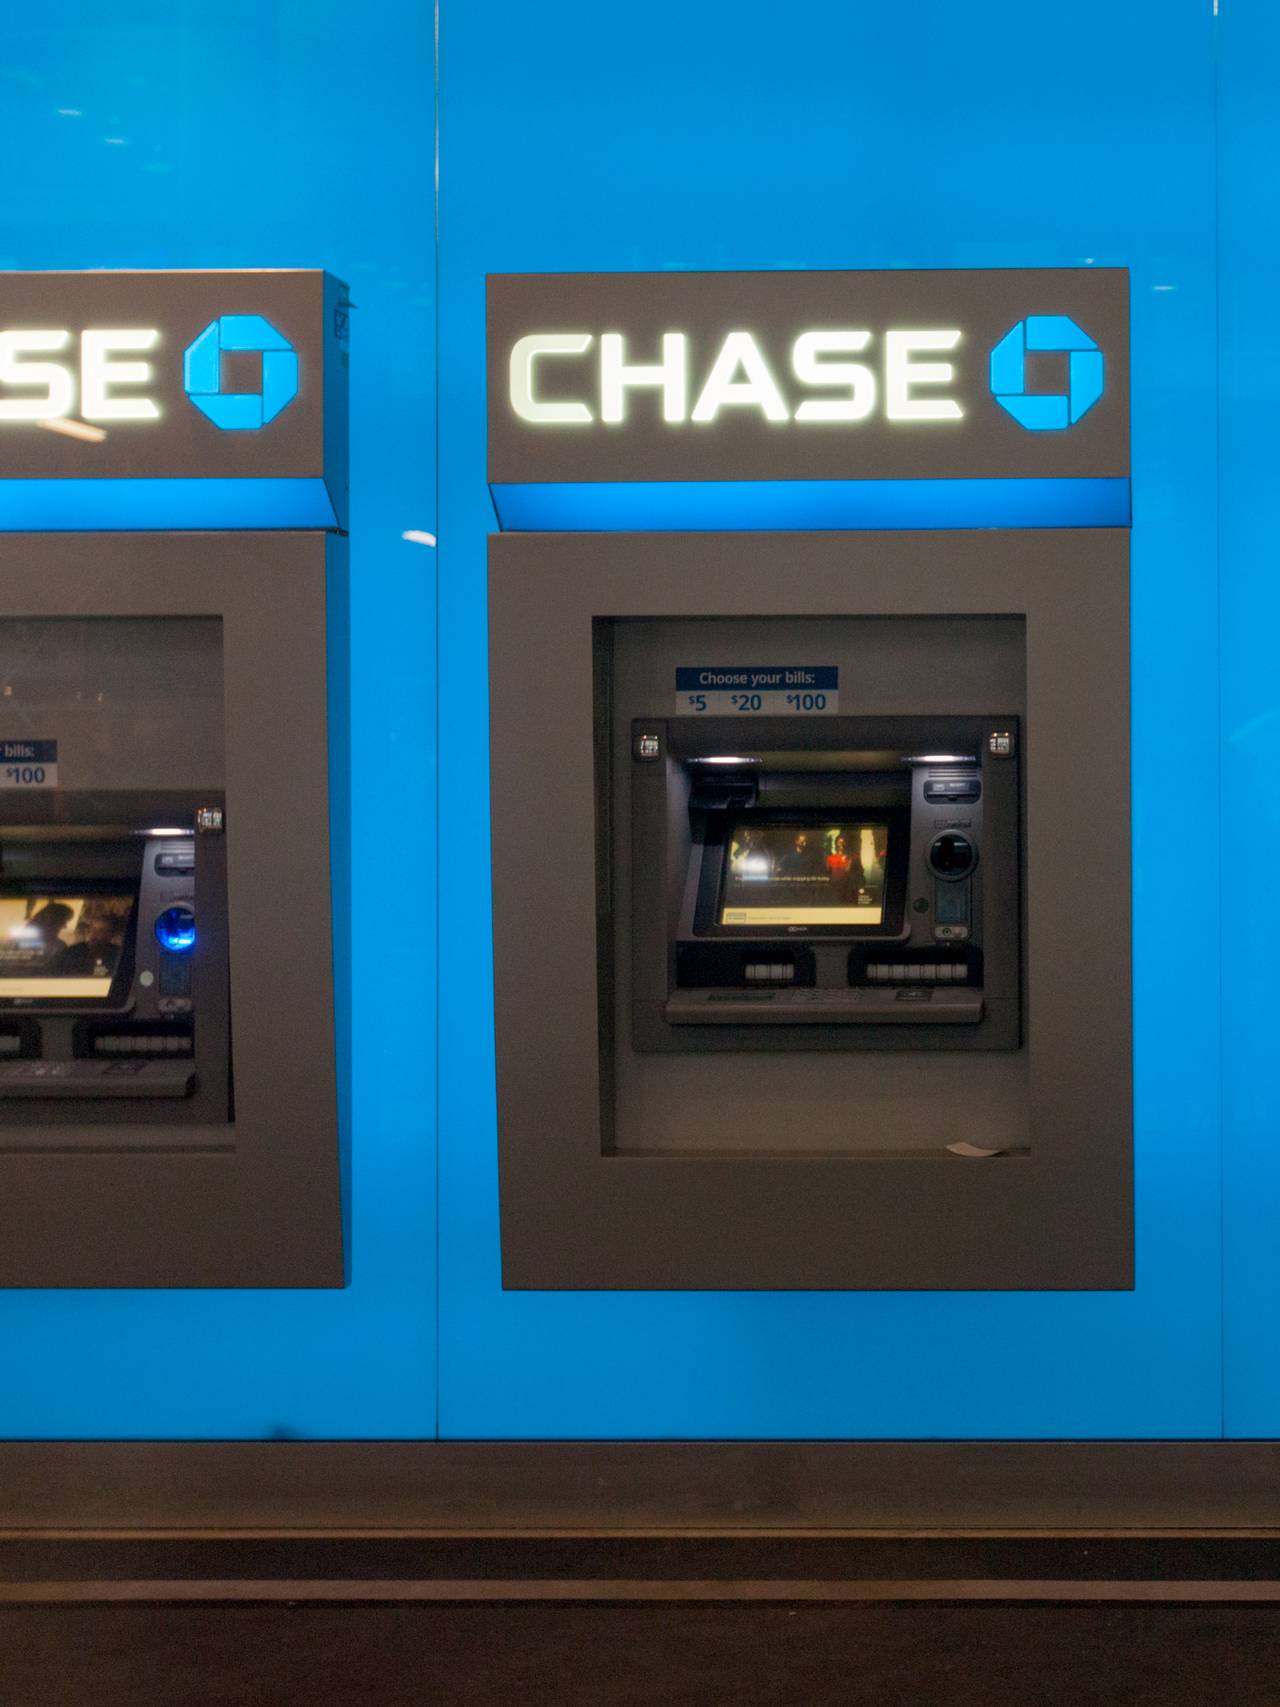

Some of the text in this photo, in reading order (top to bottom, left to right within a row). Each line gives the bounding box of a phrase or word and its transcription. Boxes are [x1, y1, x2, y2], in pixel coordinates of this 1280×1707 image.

[509, 330, 964, 422] CHASE
[700, 671, 816, 687] Choose your bills:
[688, 694, 827, 711] $5 $20 $100
[7, 767, 46, 784] $100
